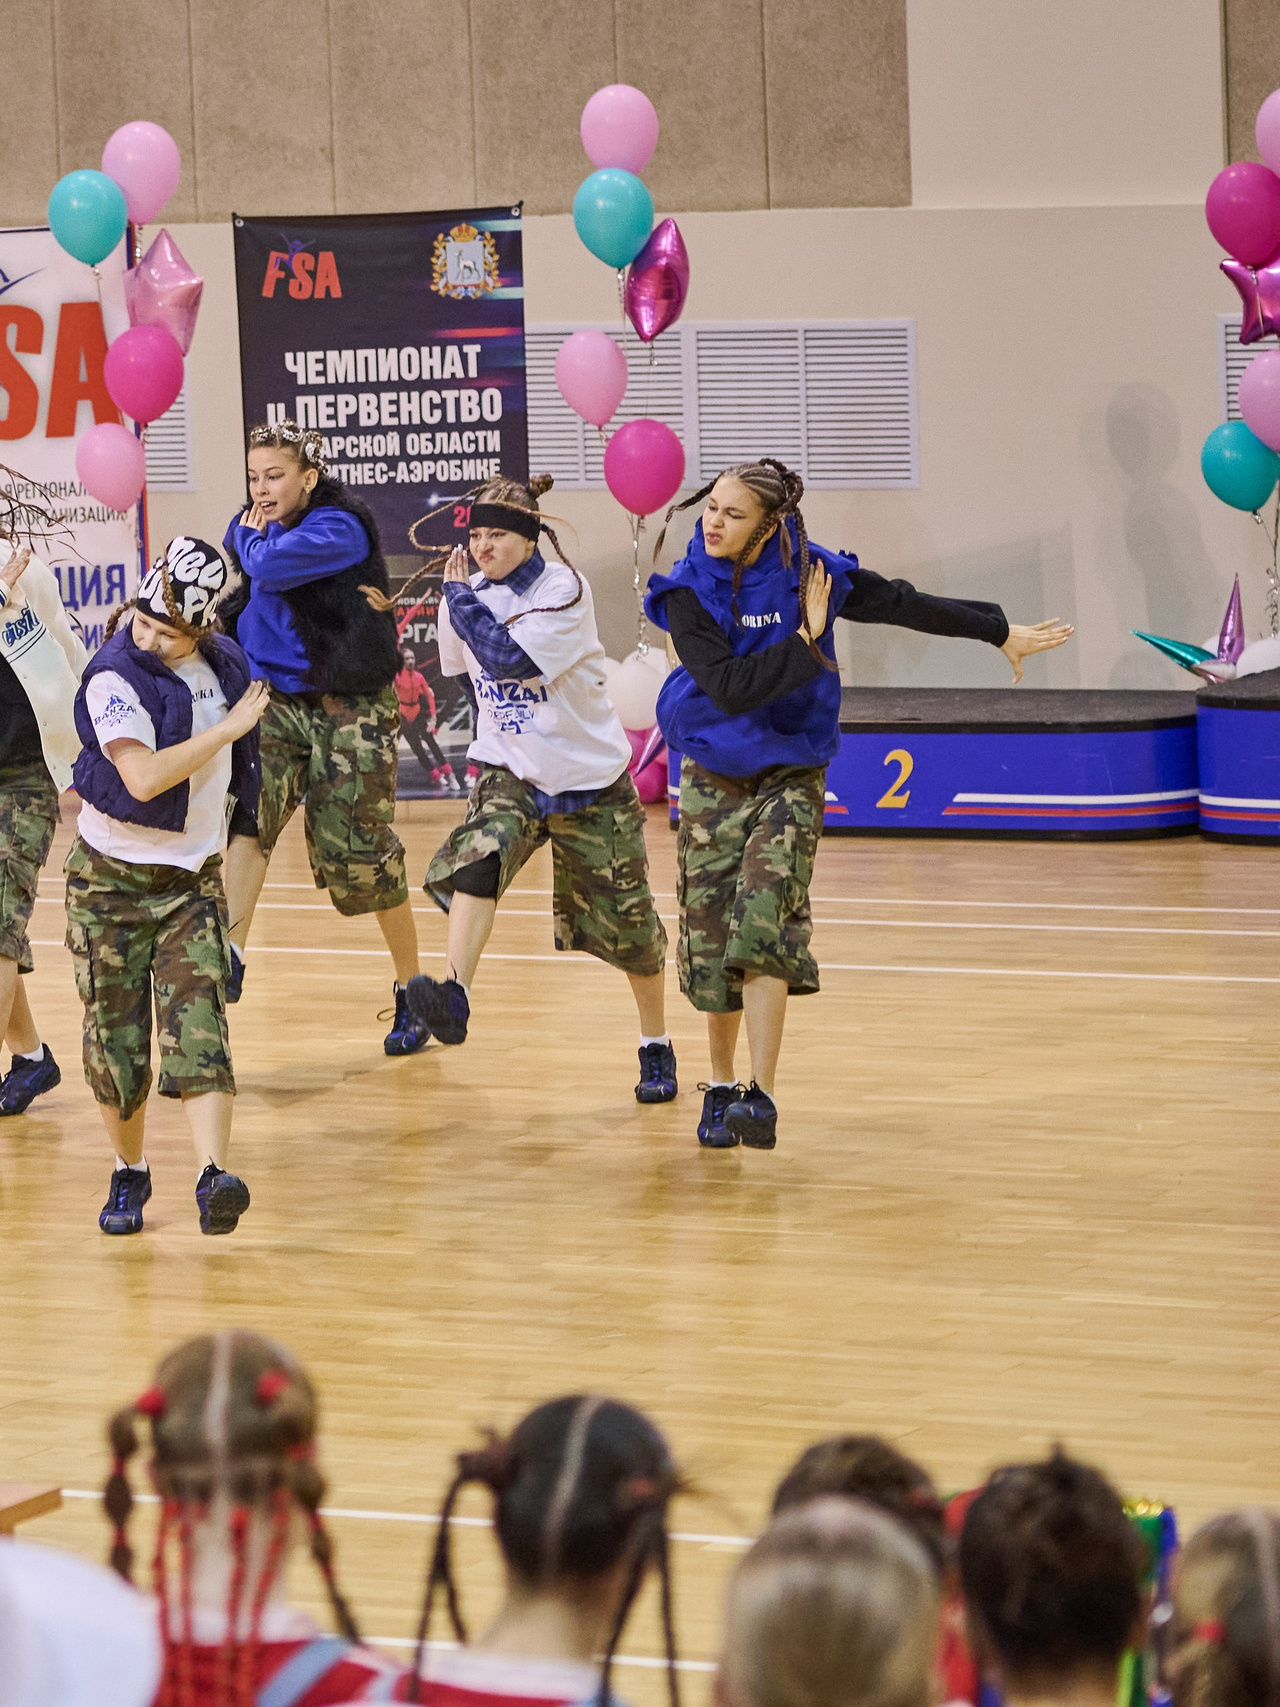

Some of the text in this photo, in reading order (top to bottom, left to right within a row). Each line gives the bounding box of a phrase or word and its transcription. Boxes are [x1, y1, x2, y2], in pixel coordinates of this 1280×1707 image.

[261, 251, 343, 300] FSA
[284, 344, 482, 385] ЧЕМПИОНАТ
[295, 387, 503, 429] ПЕРВЕНСТВО
[321, 430, 501, 459] АРСКОЙ ОБЛАСТИ
[18, 481, 90, 500] РЕГИОНАЛ
[326, 458, 501, 486] ИТНЕС-АЭРОБИКЕ
[54, 563, 126, 612] ЦИЯ
[736, 611, 782, 628] ORINA
[876, 749, 914, 808] 2
